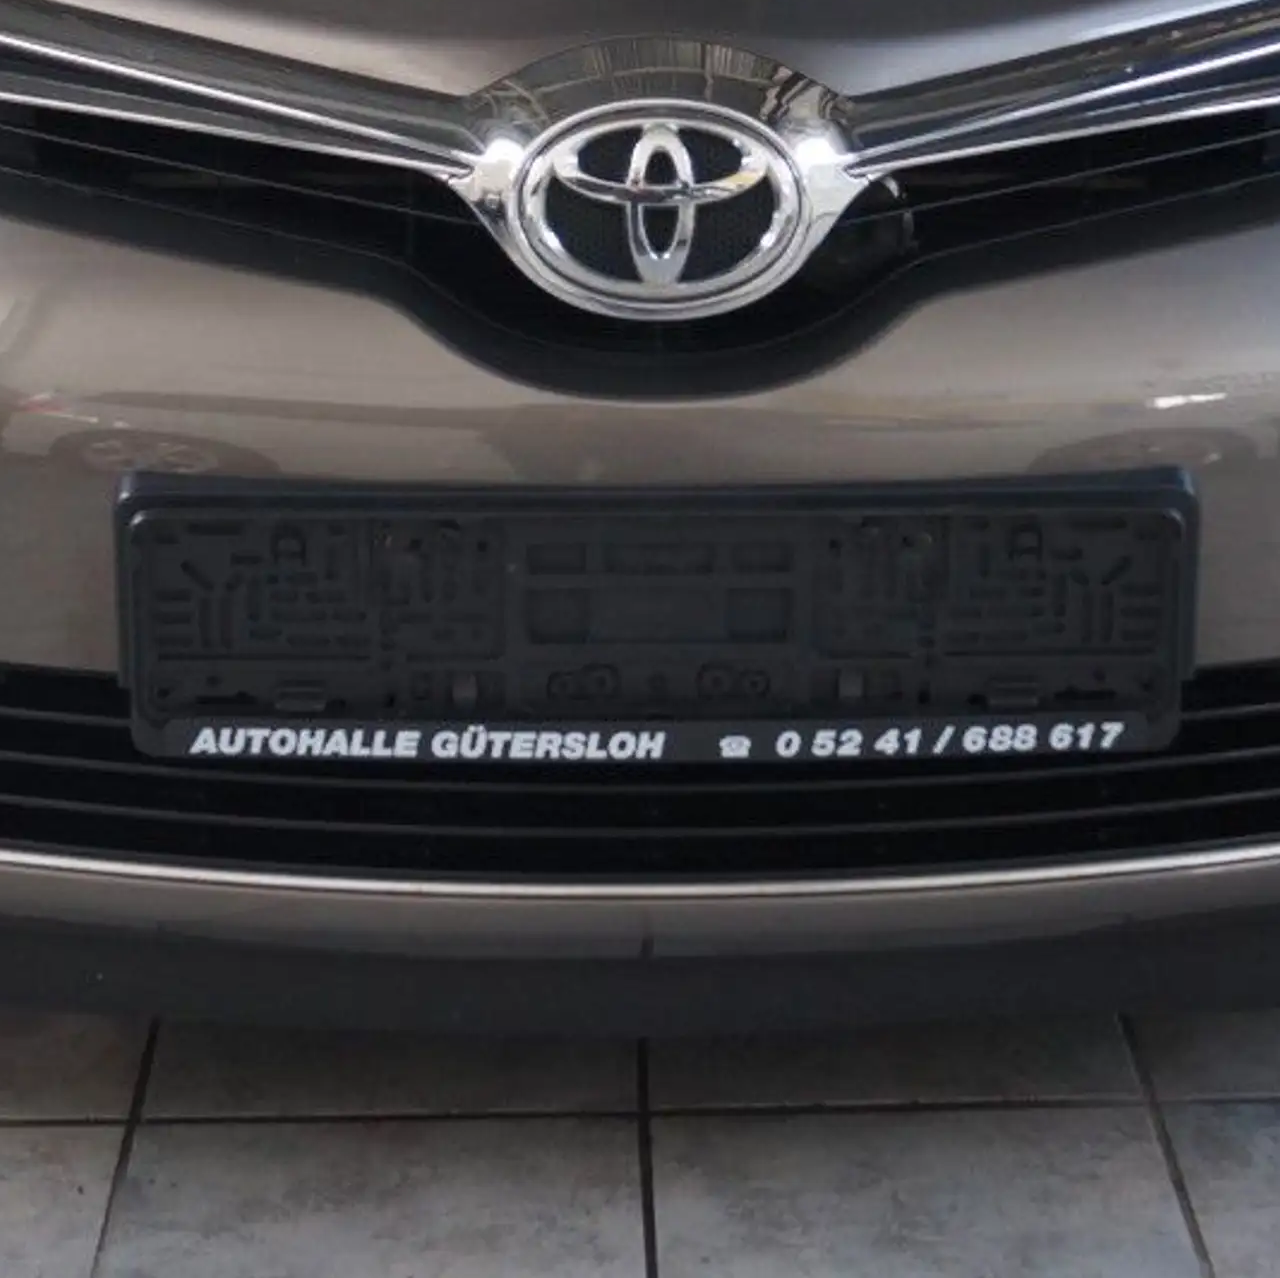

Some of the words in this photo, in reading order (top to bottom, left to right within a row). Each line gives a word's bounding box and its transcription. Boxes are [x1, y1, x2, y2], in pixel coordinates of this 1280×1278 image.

[190, 726, 421, 758] AUTOHALLE
[431, 724, 665, 760] GÜTERSLOH
[776, 730, 801, 758] 0
[811, 728, 863, 757] 52
[874, 727, 921, 756] 41
[963, 723, 1037, 754] 688
[1048, 721, 1124, 751] 617
